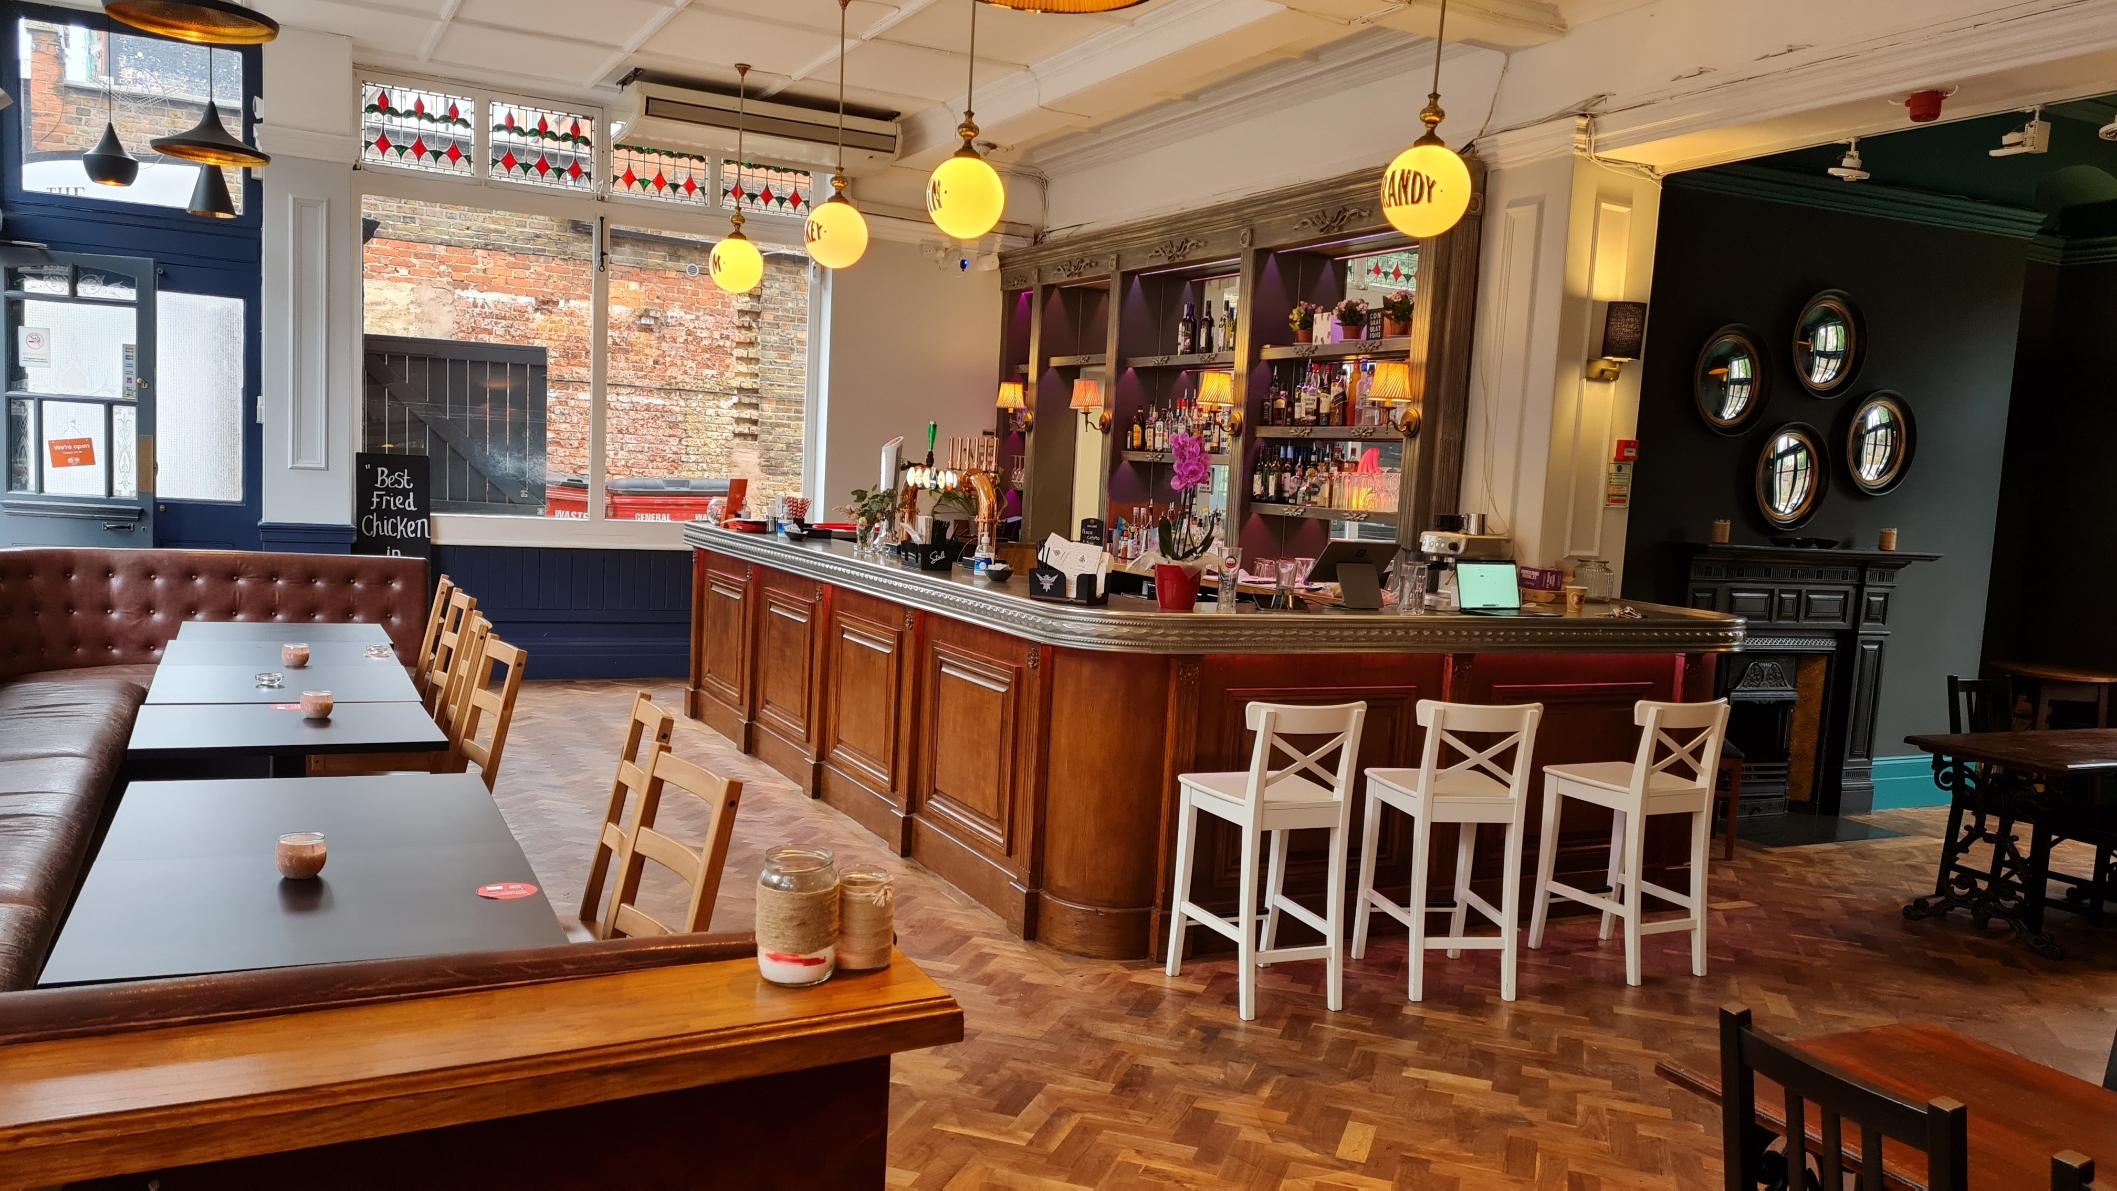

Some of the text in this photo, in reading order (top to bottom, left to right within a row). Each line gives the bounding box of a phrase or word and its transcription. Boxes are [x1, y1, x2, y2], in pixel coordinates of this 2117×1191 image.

[370, 491, 418, 511] Fried
[361, 512, 431, 539] Chicken
[635, 513, 671, 522] GENERAL
